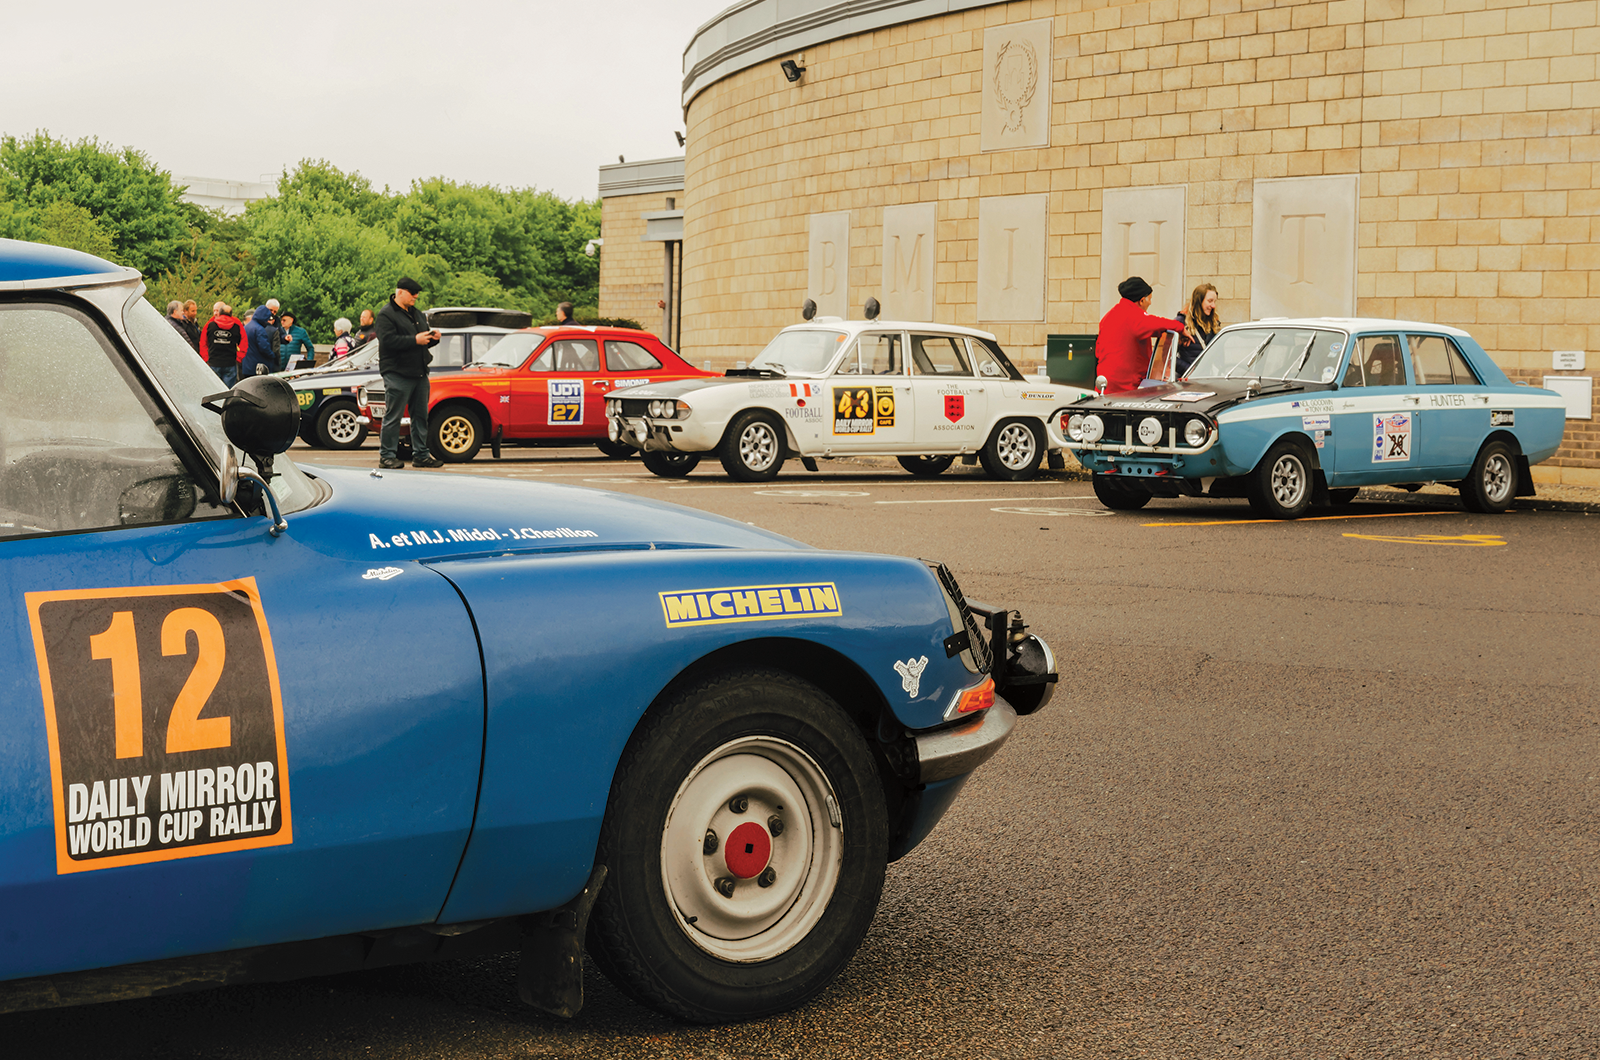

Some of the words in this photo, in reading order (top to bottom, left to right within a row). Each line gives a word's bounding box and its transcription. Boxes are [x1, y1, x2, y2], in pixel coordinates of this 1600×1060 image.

[889, 232, 926, 294] M
[1002, 227, 1019, 291] I
[1117, 219, 1167, 287] H
[1279, 212, 1327, 285] T
[552, 384, 581, 396] UDT
[614, 379, 650, 388] SIMONIZ
[297, 393, 314, 406] BP
[838, 389, 869, 419] 43
[1429, 395, 1466, 406] HUNTER
[553, 404, 579, 420] 27
[785, 407, 823, 419] FOOTBALL
[368, 533, 391, 549] A.
[390, 534, 413, 547] et
[447, 528, 502, 542] Midol
[369, 567, 399, 578] Michelin
[664, 586, 838, 621] MICHELIN
[89, 606, 232, 760] 12
[68, 774, 152, 824] DAILY
[160, 760, 275, 812] MIRROR
[68, 816, 152, 855] WORLD
[158, 809, 203, 844] CUP
[209, 799, 277, 838] RALLY
